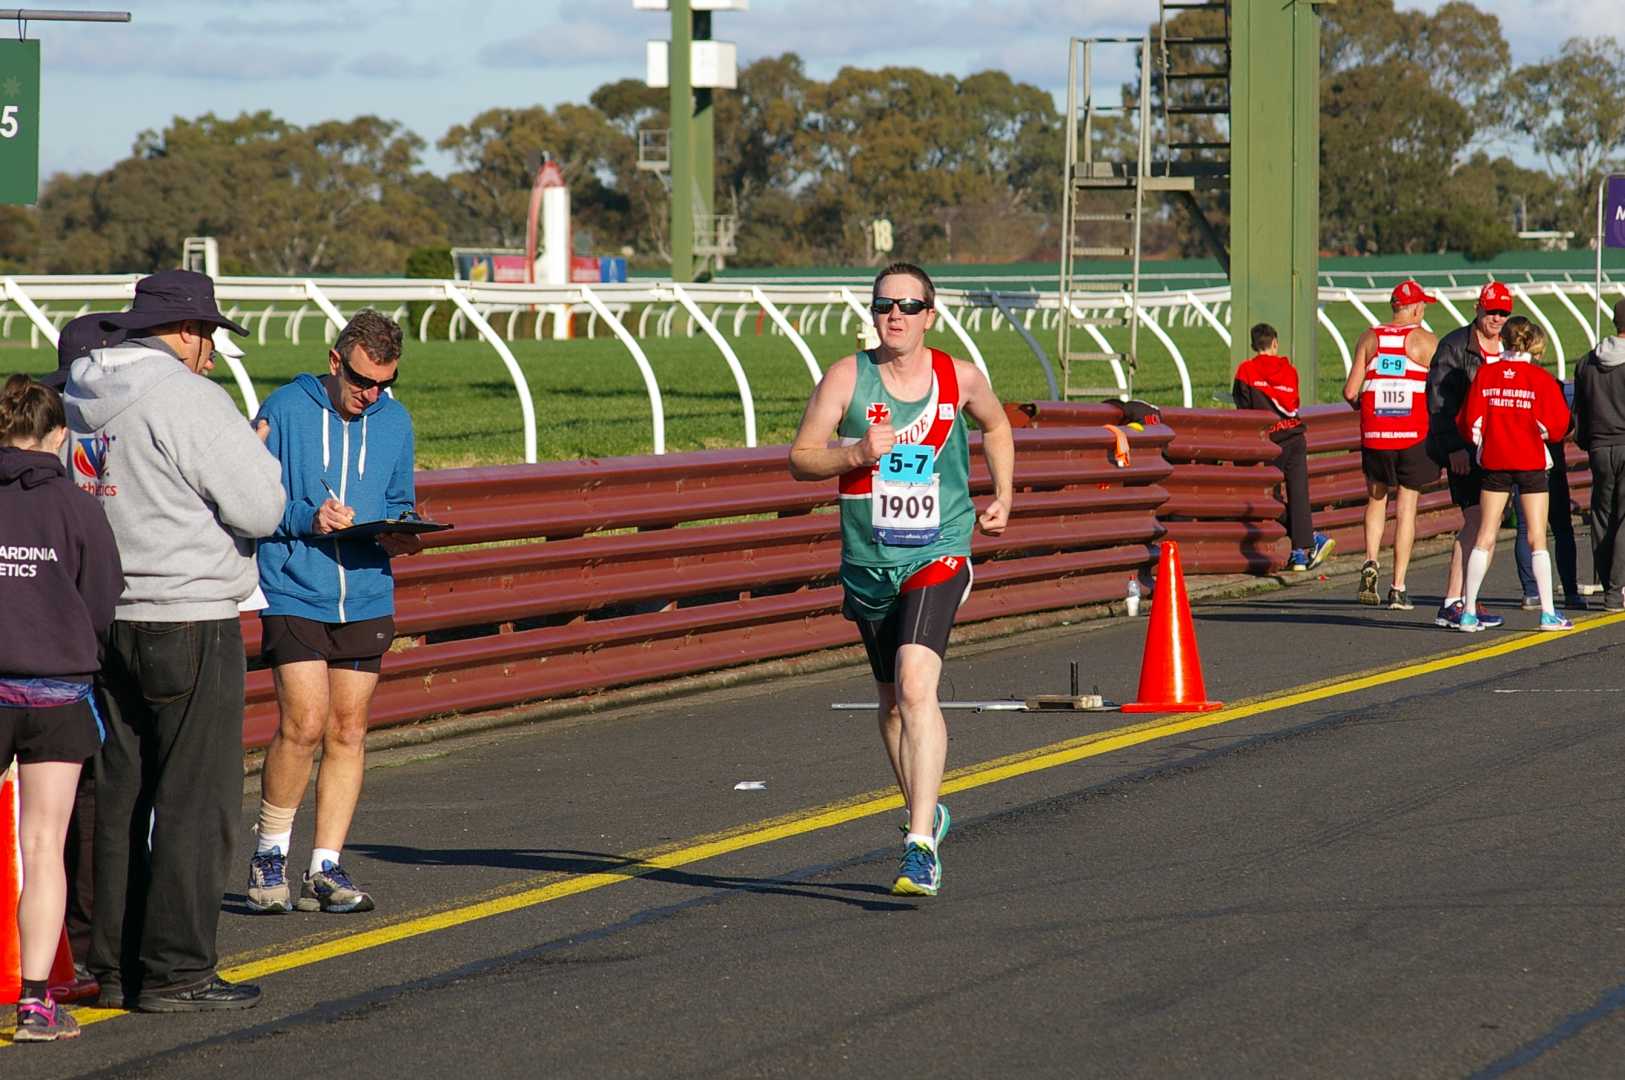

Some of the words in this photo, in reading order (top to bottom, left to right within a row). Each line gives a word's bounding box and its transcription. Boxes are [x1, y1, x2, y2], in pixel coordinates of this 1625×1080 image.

[0, 105, 18, 138] 5
[873, 219, 893, 252] 18
[1382, 358, 1402, 370] 6-9
[1382, 391, 1405, 403] 1115
[1516, 400, 1532, 409] CLUB
[888, 453, 928, 474] 5-7
[880, 494, 934, 519] 1909
